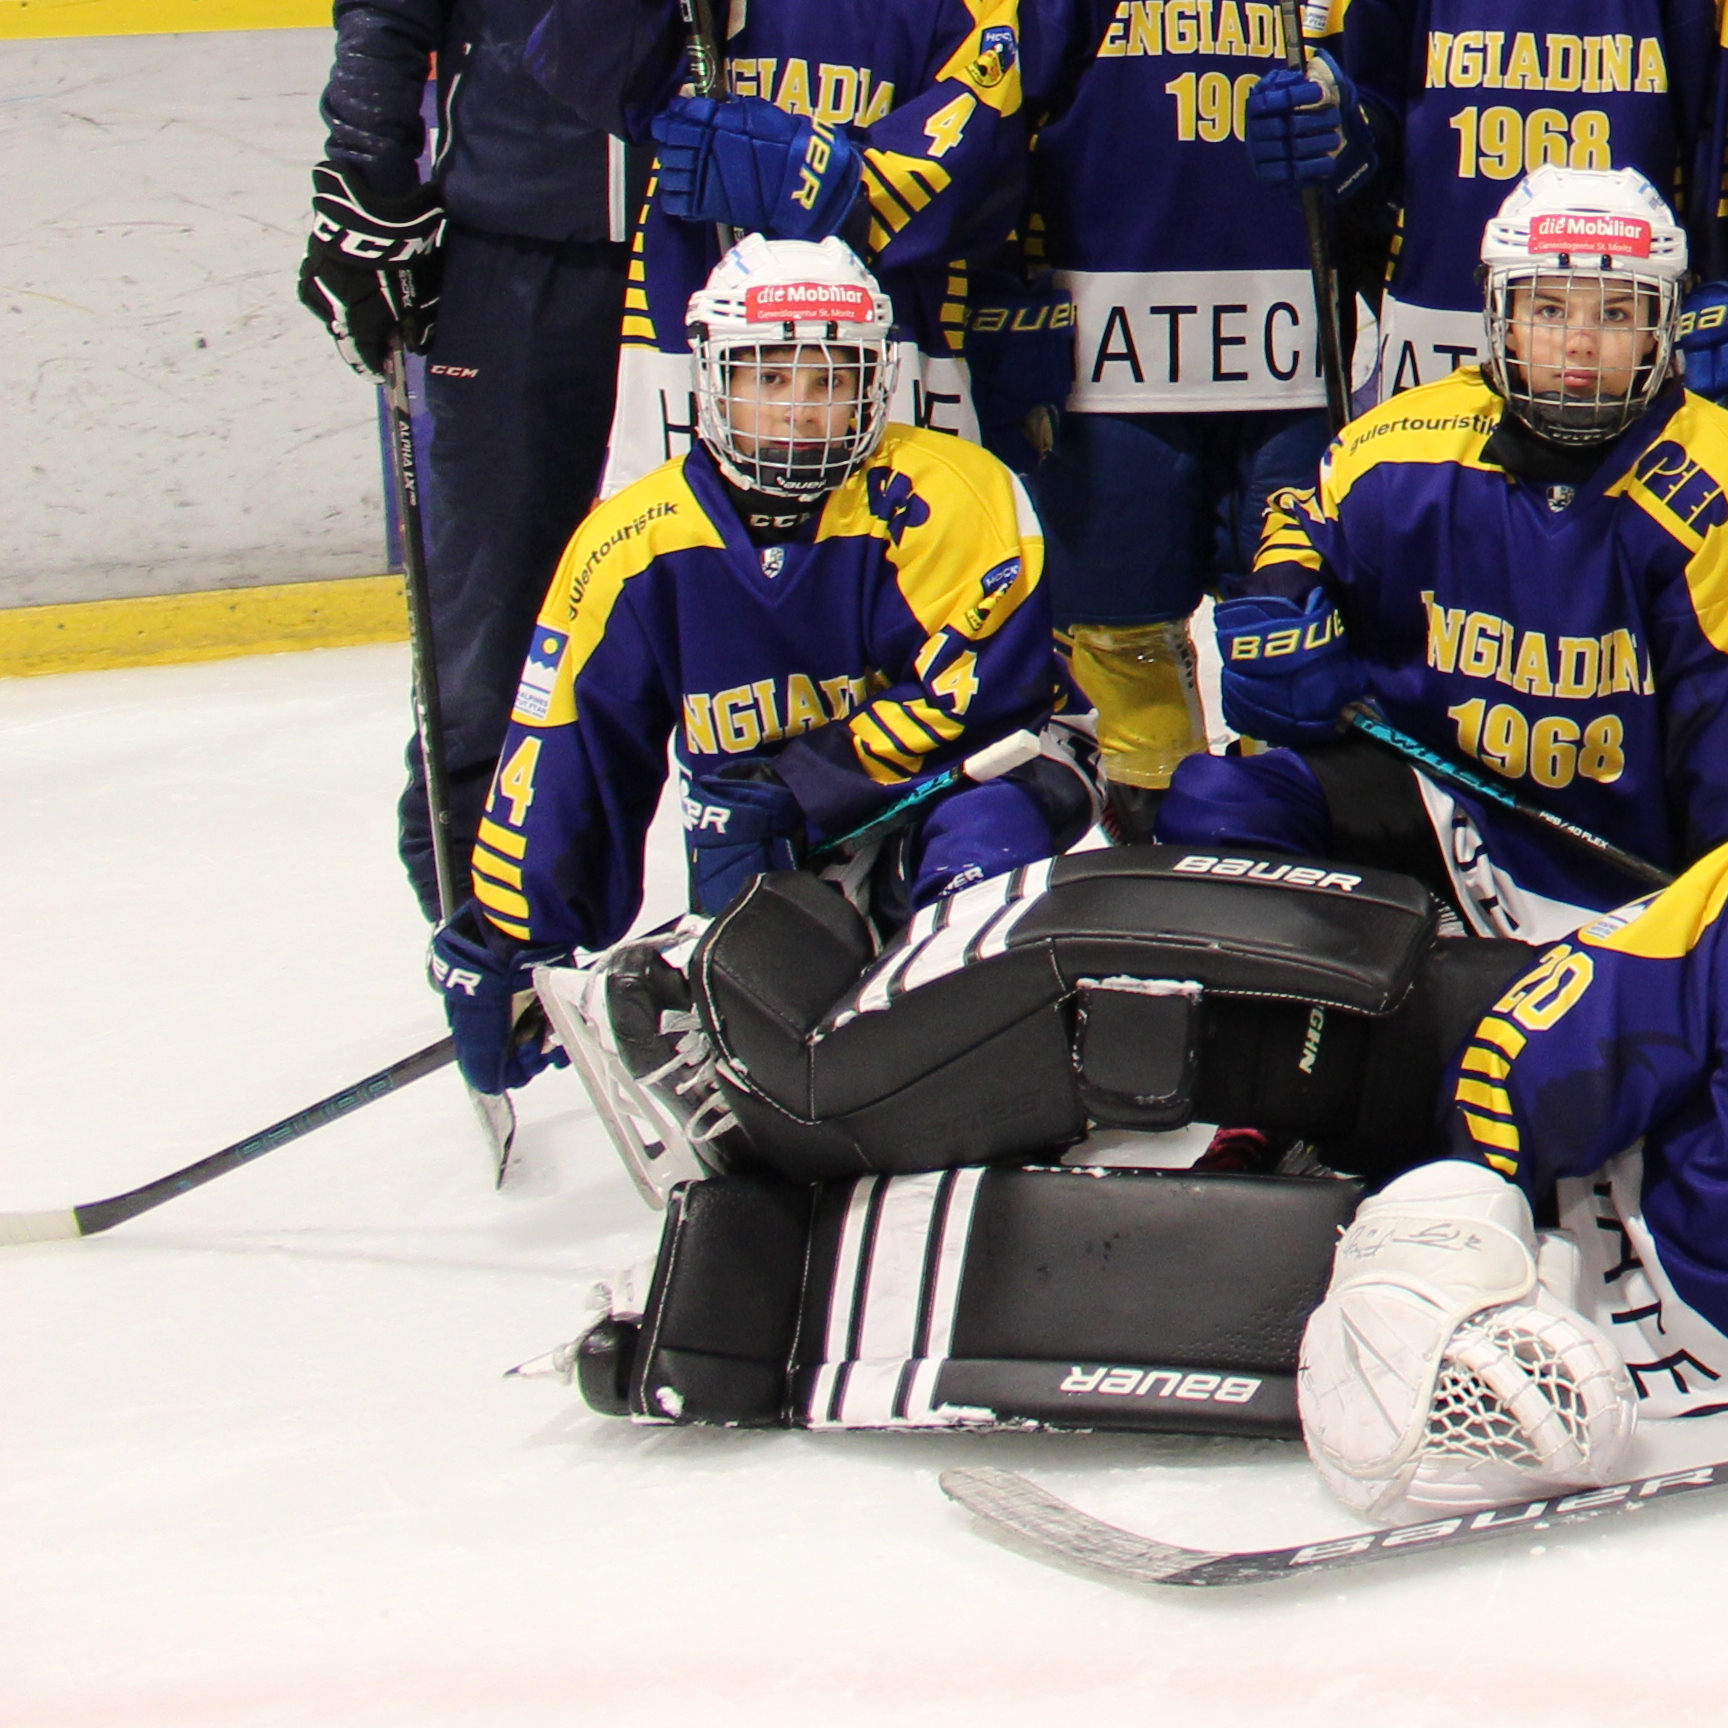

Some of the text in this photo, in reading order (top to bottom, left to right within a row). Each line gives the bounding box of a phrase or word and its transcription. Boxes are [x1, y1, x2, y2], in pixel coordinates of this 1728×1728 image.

[1425, 30, 1668, 94] NGIADINA
[923, 92, 977, 159] 4
[1449, 106, 1613, 180] 1968
[311, 217, 441, 264] CCM
[1568, 219, 1643, 239] Mobiliar
[787, 285, 865, 304] Mobiliar
[1347, 411, 1501, 457] gulertouristik
[565, 499, 680, 620] gulertouristik
[1230, 609, 1345, 661] BAUE
[1447, 696, 1626, 791] 1968
[1493, 944, 1594, 1032] 20
